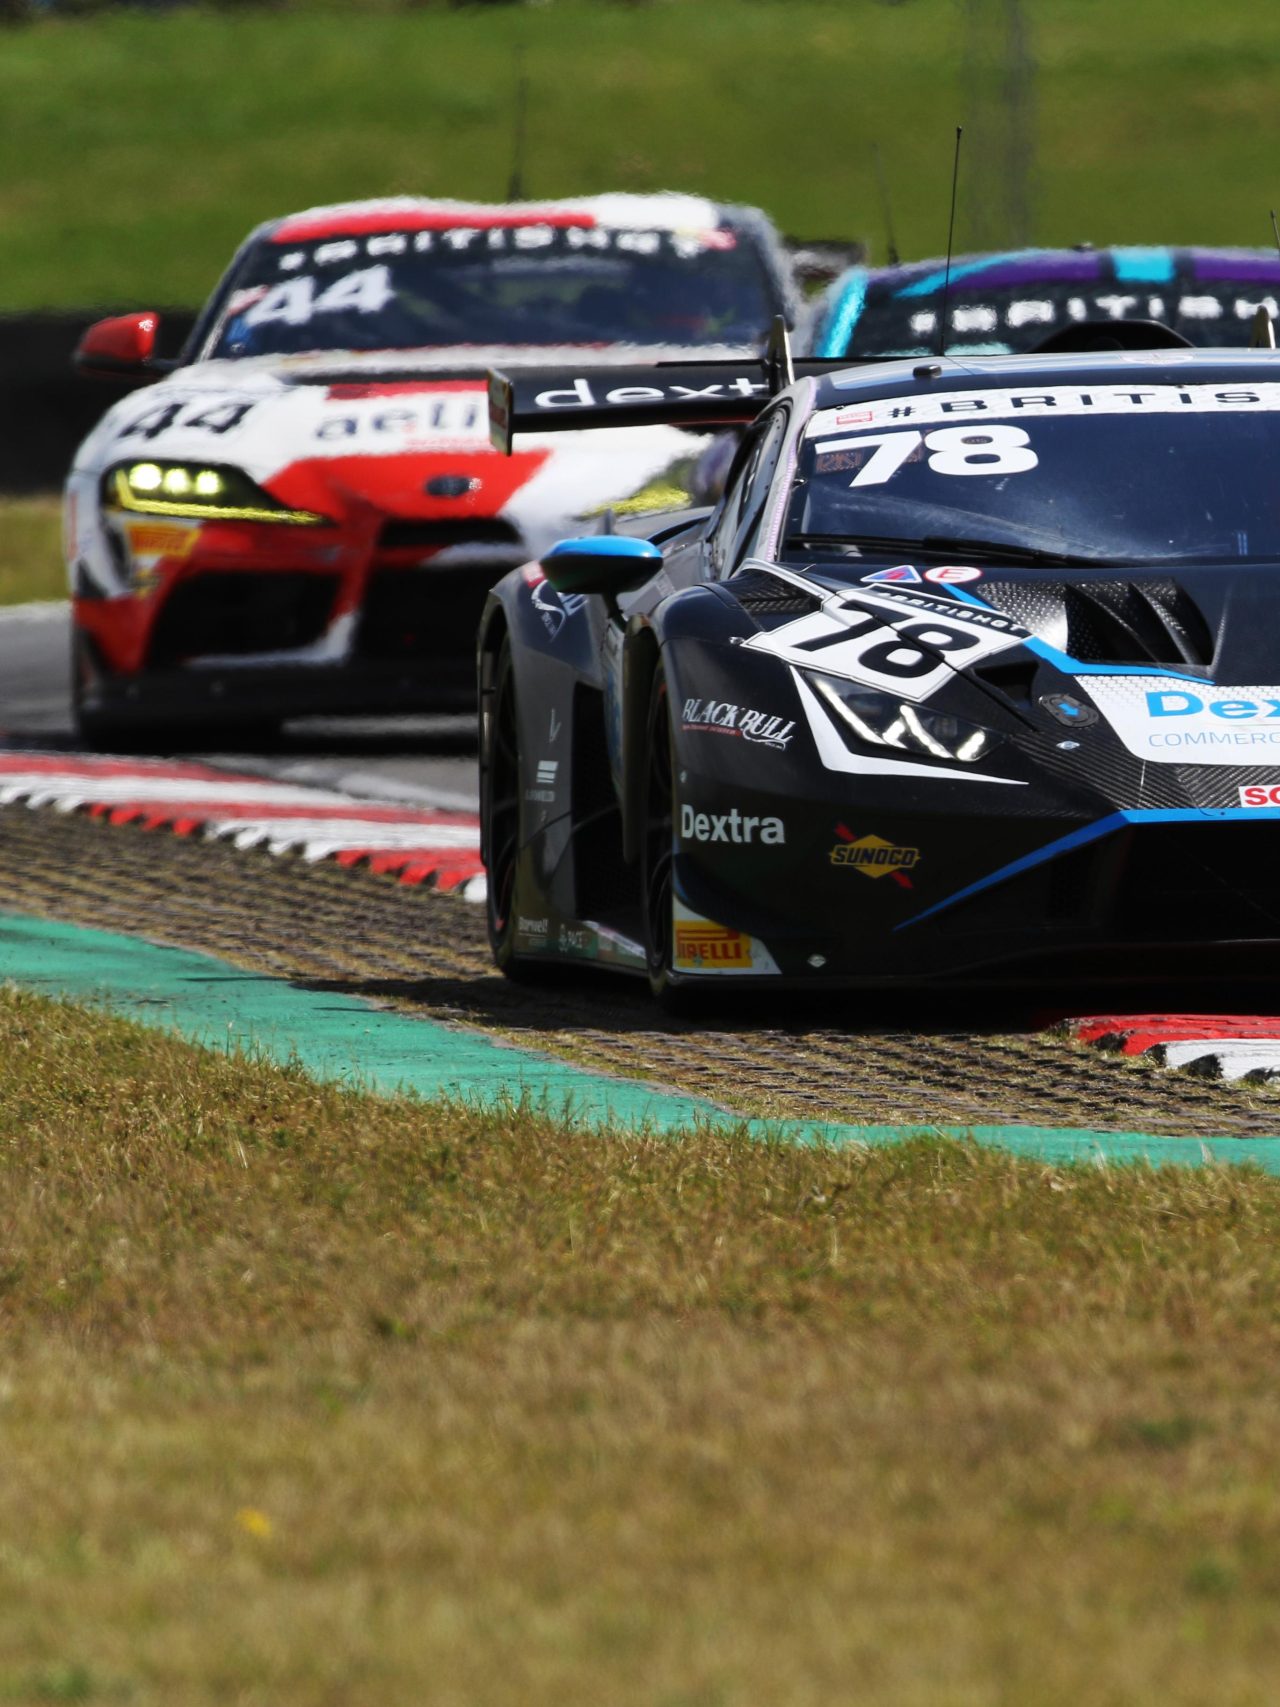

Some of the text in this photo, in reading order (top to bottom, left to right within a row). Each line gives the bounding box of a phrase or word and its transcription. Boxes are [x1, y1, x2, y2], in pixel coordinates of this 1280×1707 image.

[244, 264, 395, 327] 44
[119, 402, 254, 439] 44
[815, 424, 1039, 488] 78
[790, 599, 981, 678] 78
[681, 699, 745, 730] BLACK
[739, 707, 796, 743] BULL
[681, 804, 785, 844] Dextra
[834, 847, 917, 866] SUNOCO
[677, 929, 742, 961] PIRELLI
